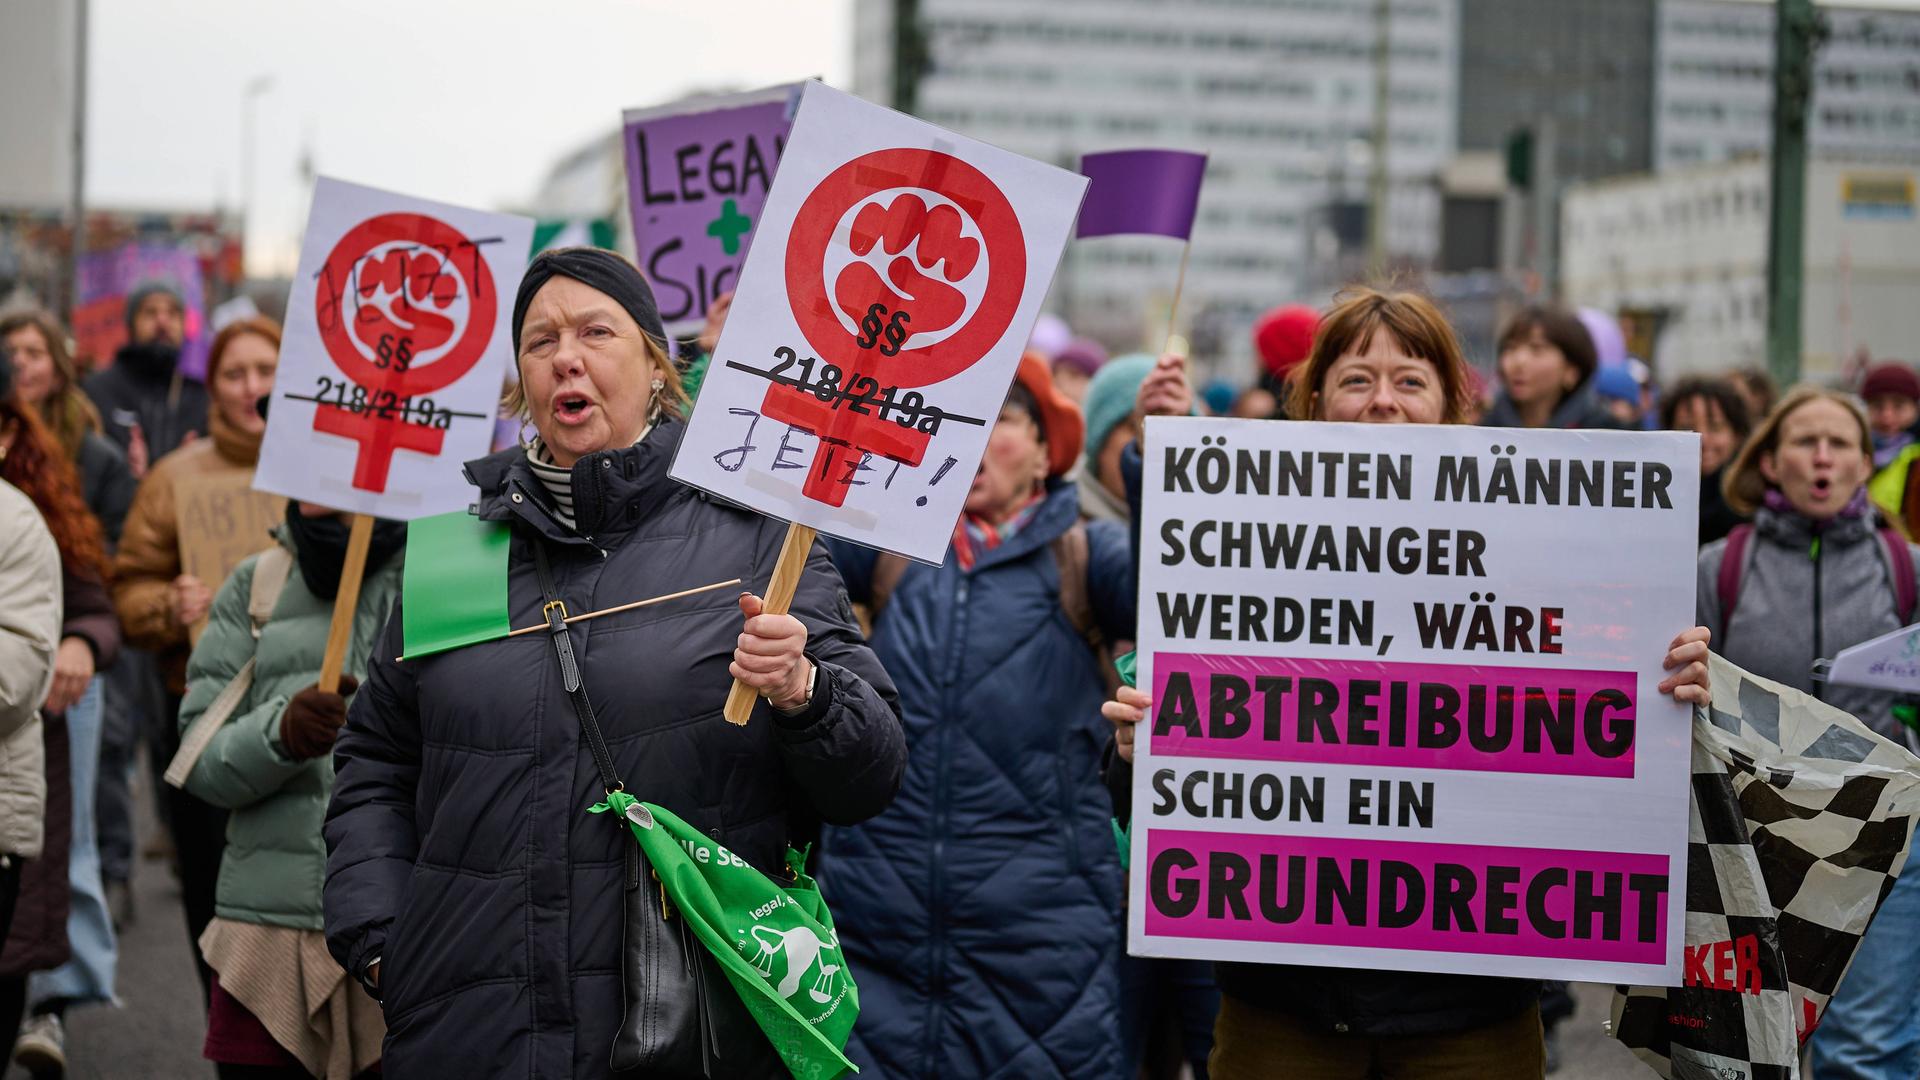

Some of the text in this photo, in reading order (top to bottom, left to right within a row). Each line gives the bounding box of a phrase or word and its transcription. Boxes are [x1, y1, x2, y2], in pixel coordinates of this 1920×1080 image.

[637, 128, 785, 204] LEGA
[313, 236, 506, 335] JETZT
[373, 332, 413, 374] §§
[857, 302, 911, 357] §§
[313, 376, 452, 431] 218/219a
[766, 345, 945, 436] 218/219a
[1163, 435, 1673, 510] KÖNNTEN MÄNNER
[1160, 519, 1487, 577] SCHWANGER
[1156, 591, 1565, 656] WERDEN, WÄRE
[1152, 671, 1635, 759] ABTREIBUNG
[1152, 769, 1434, 829] SCHON EIN
[749, 894, 786, 921] legal,
[1149, 847, 1669, 945] GRUNDRECHT
[1684, 933, 1762, 996] KER
[807, 983, 848, 1025] chaftsabbruch
